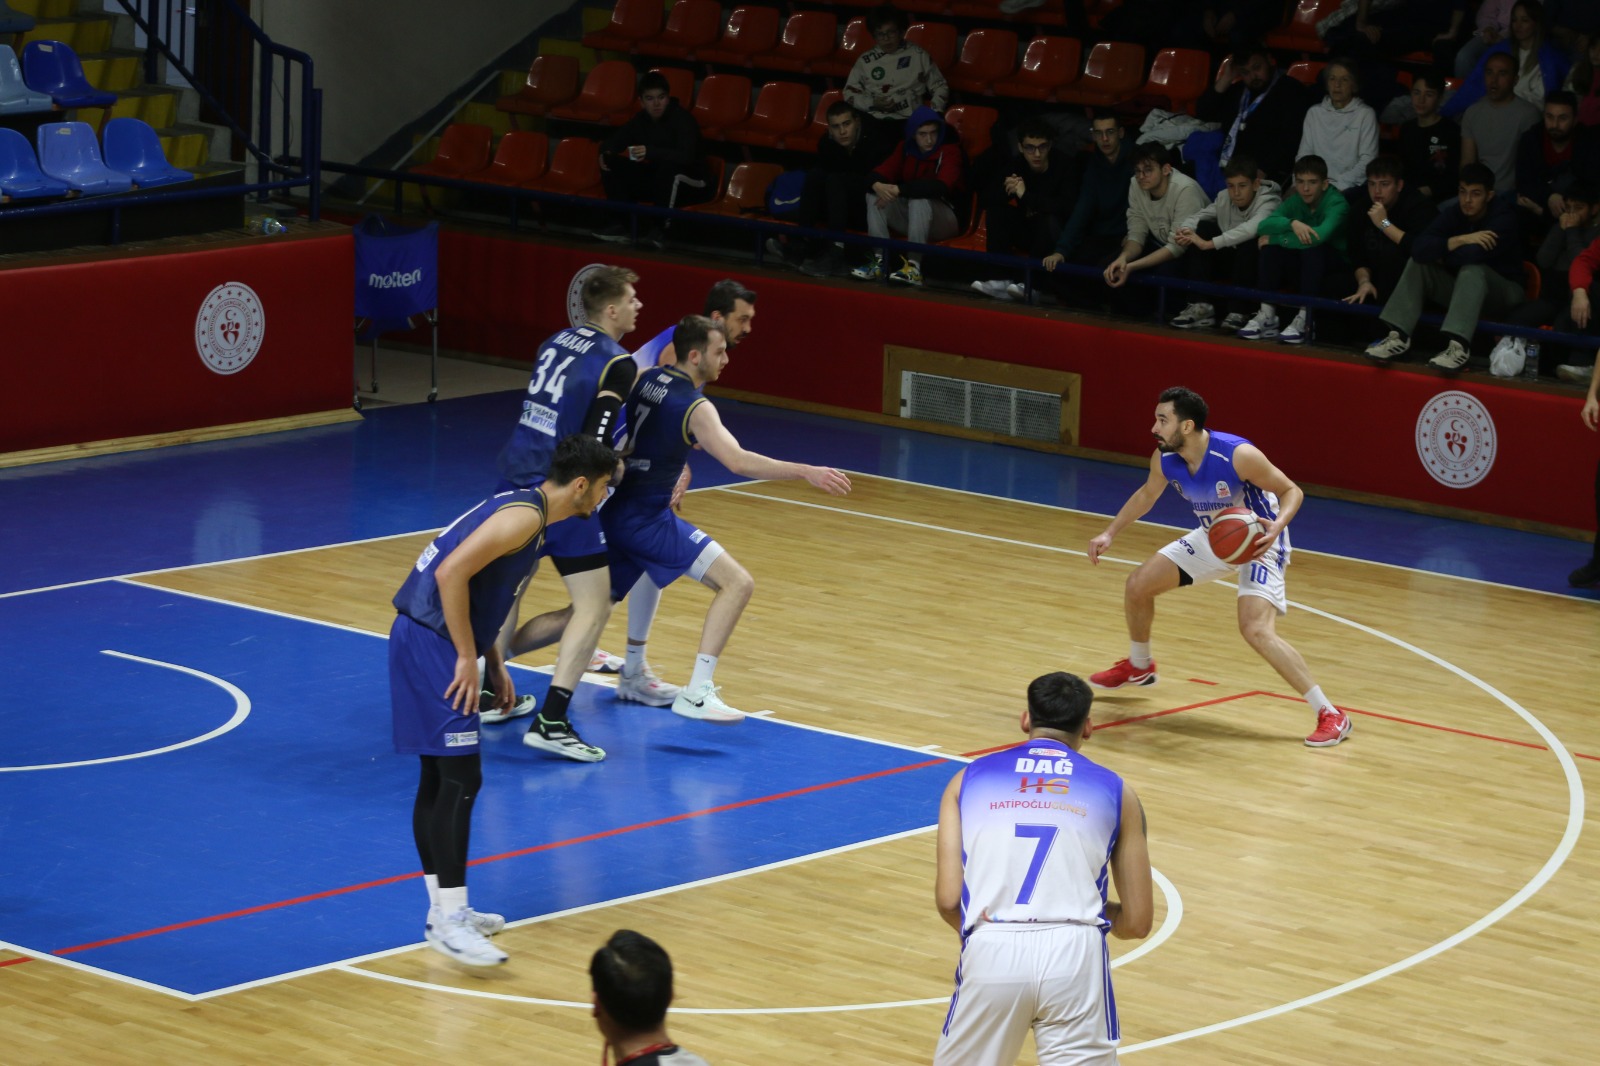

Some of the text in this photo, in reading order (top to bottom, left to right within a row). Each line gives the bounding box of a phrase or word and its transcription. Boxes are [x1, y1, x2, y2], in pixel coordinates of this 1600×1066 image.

[368, 269, 421, 289] molten
[552, 331, 595, 354] HAKAN
[527, 348, 575, 404] 34
[628, 402, 652, 451] 7
[1192, 500, 1234, 511] ELEDİYESPOR
[1250, 563, 1268, 585] 10
[1015, 758, 1073, 775] DAĞ
[1016, 777, 1070, 794] HG
[1015, 823, 1060, 904] 7
